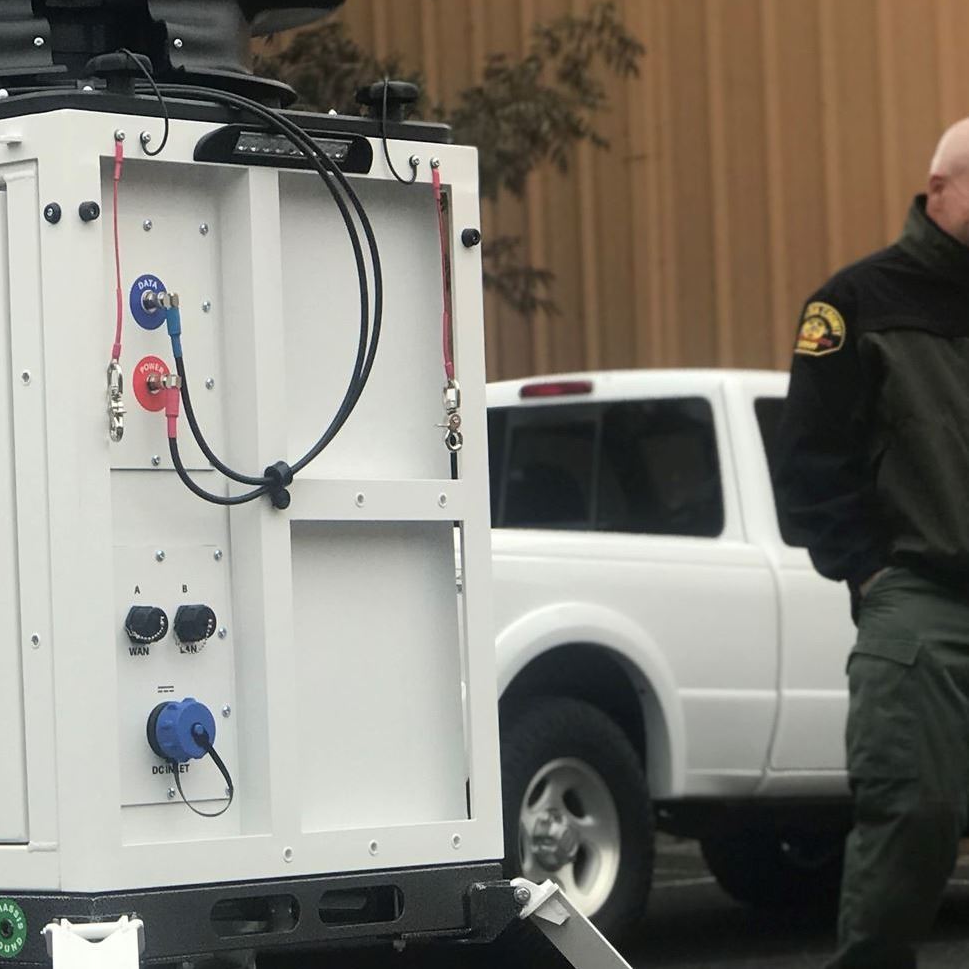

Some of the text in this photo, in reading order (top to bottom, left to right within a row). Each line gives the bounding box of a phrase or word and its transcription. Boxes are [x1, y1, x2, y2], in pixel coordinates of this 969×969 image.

[137, 279, 158, 290] DATA
[139, 362, 165, 375] POWER
[134, 584, 188, 595] A B
[129, 646, 150, 656] WAN
[152, 764, 190, 775] DC INET
